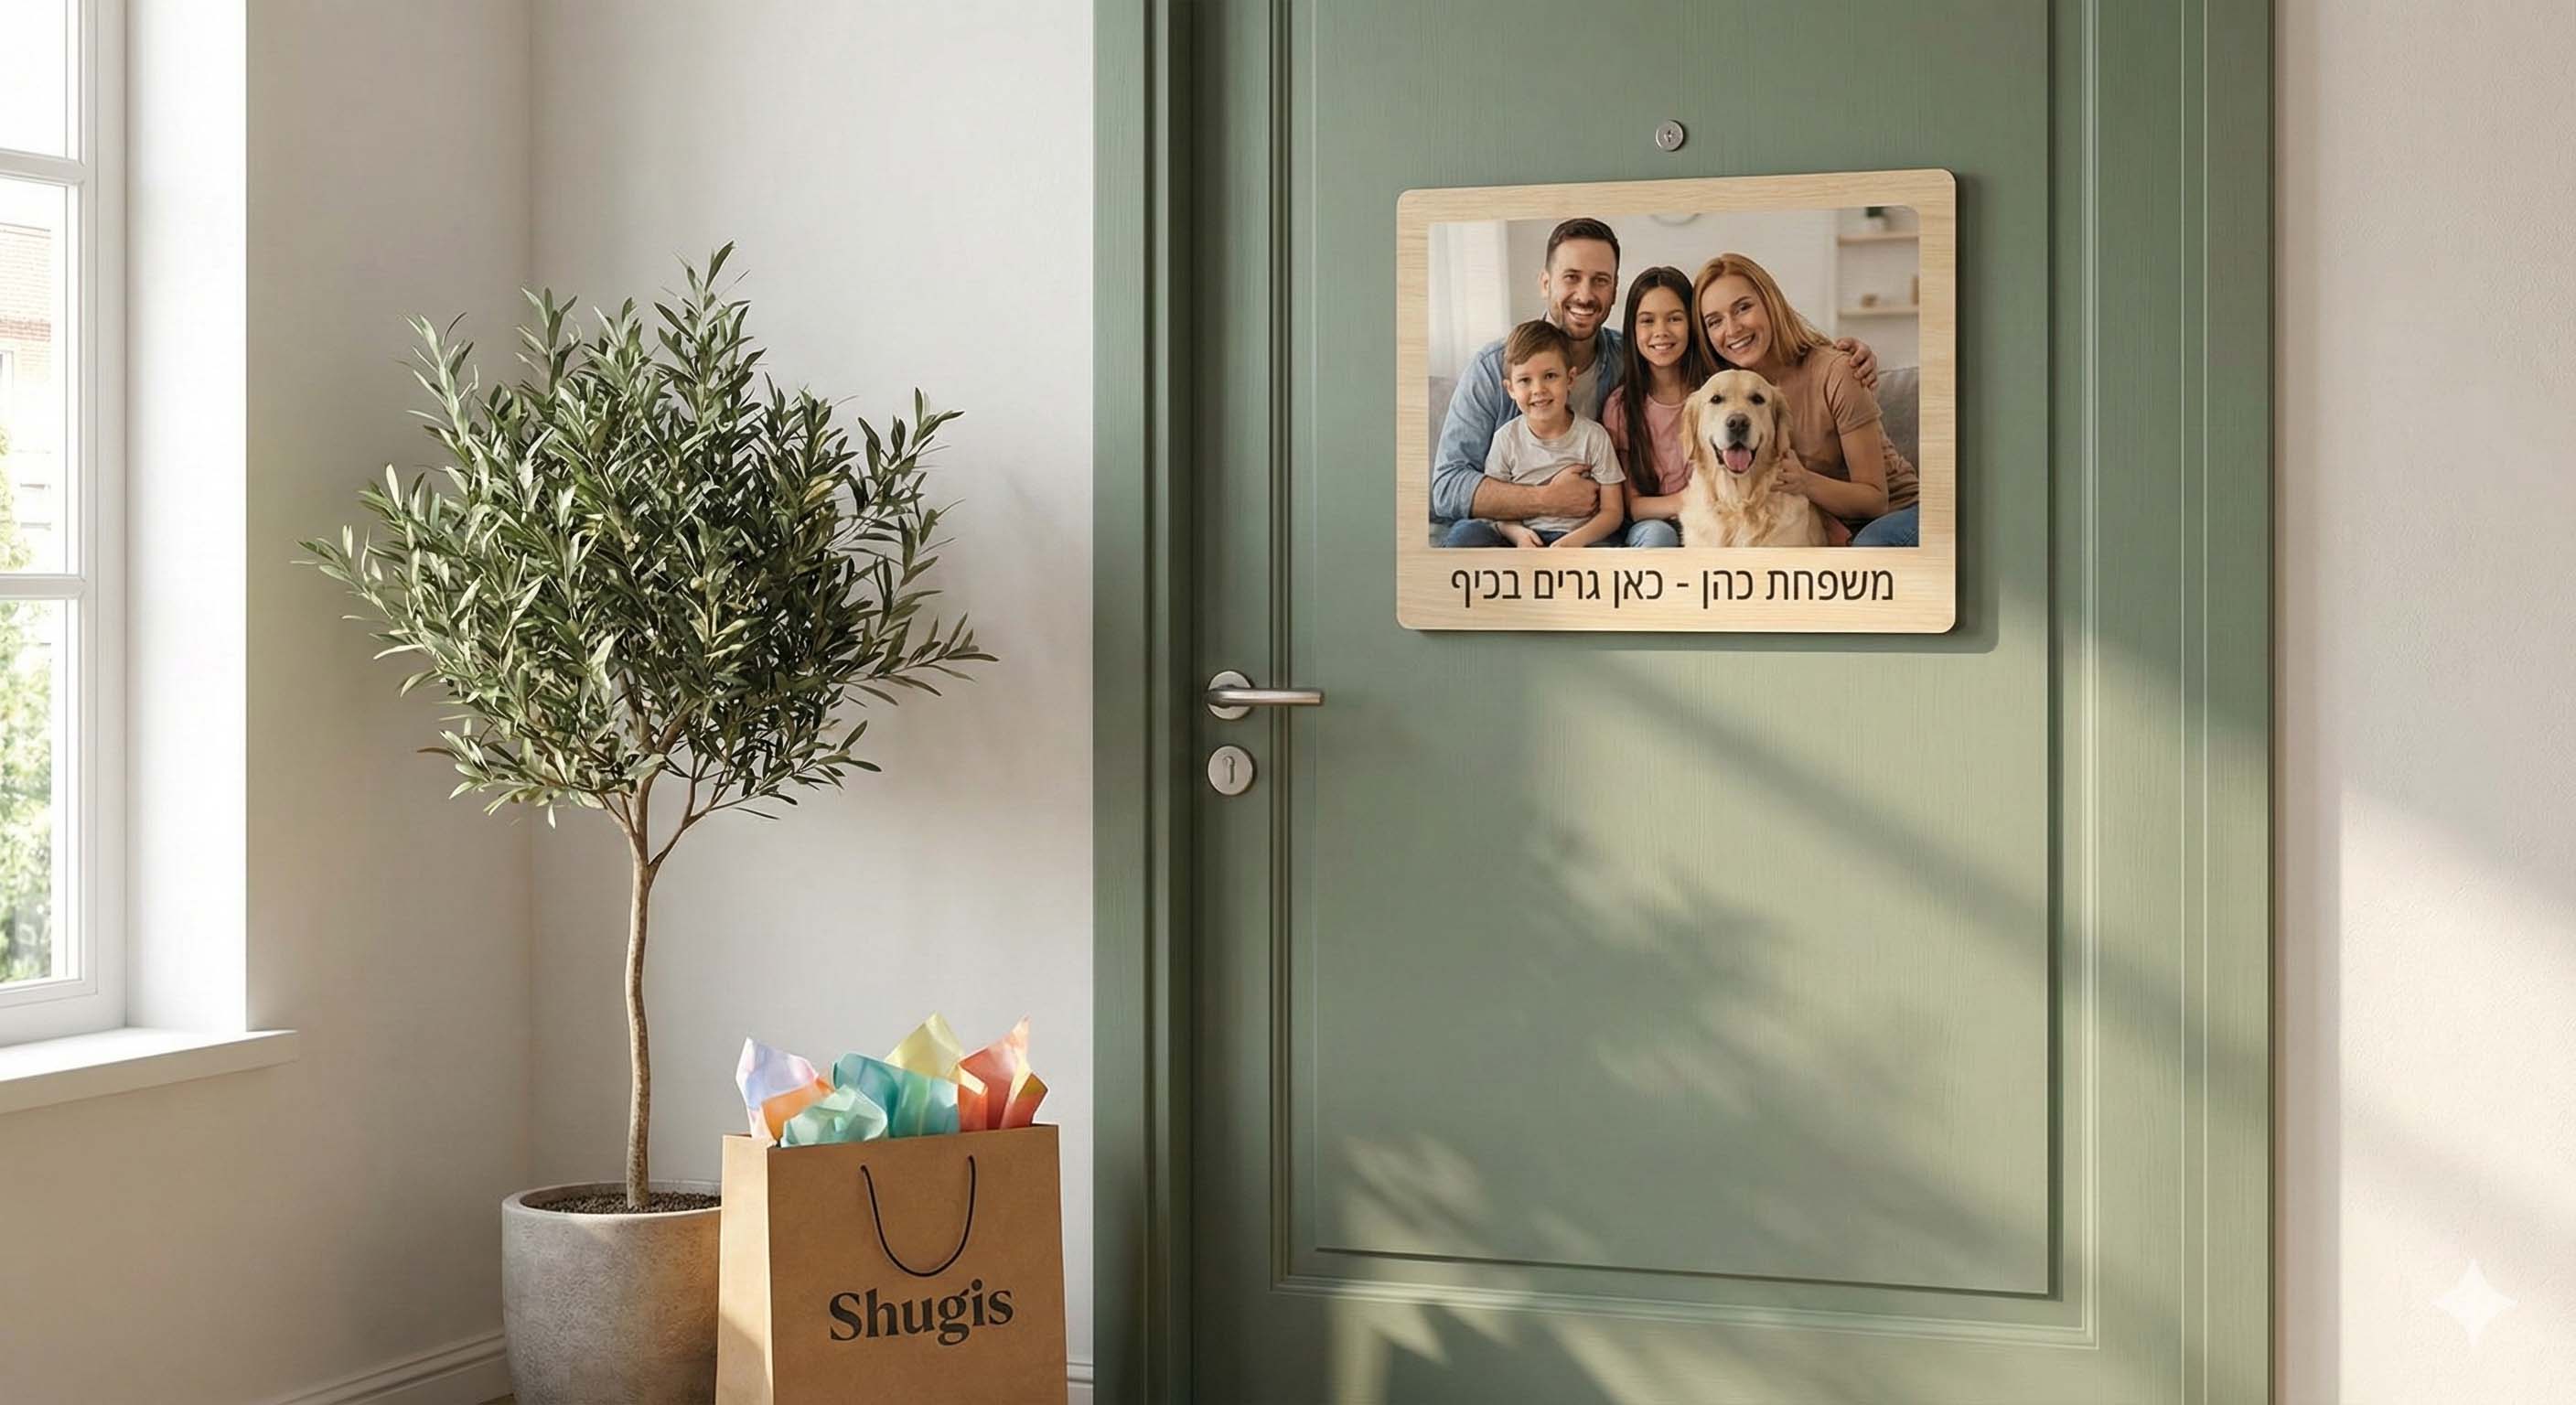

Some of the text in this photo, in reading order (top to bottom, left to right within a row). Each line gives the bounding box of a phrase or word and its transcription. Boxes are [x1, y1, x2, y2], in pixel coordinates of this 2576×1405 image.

[1450, 568, 1523, 610] בכיף
[1533, 569, 1602, 601] גרים
[1613, 569, 1664, 611] כאן
[1701, 569, 1755, 611] כהן
[1766, 569, 1894, 602] משפחת
[829, 1278, 1014, 1346] Shugis
